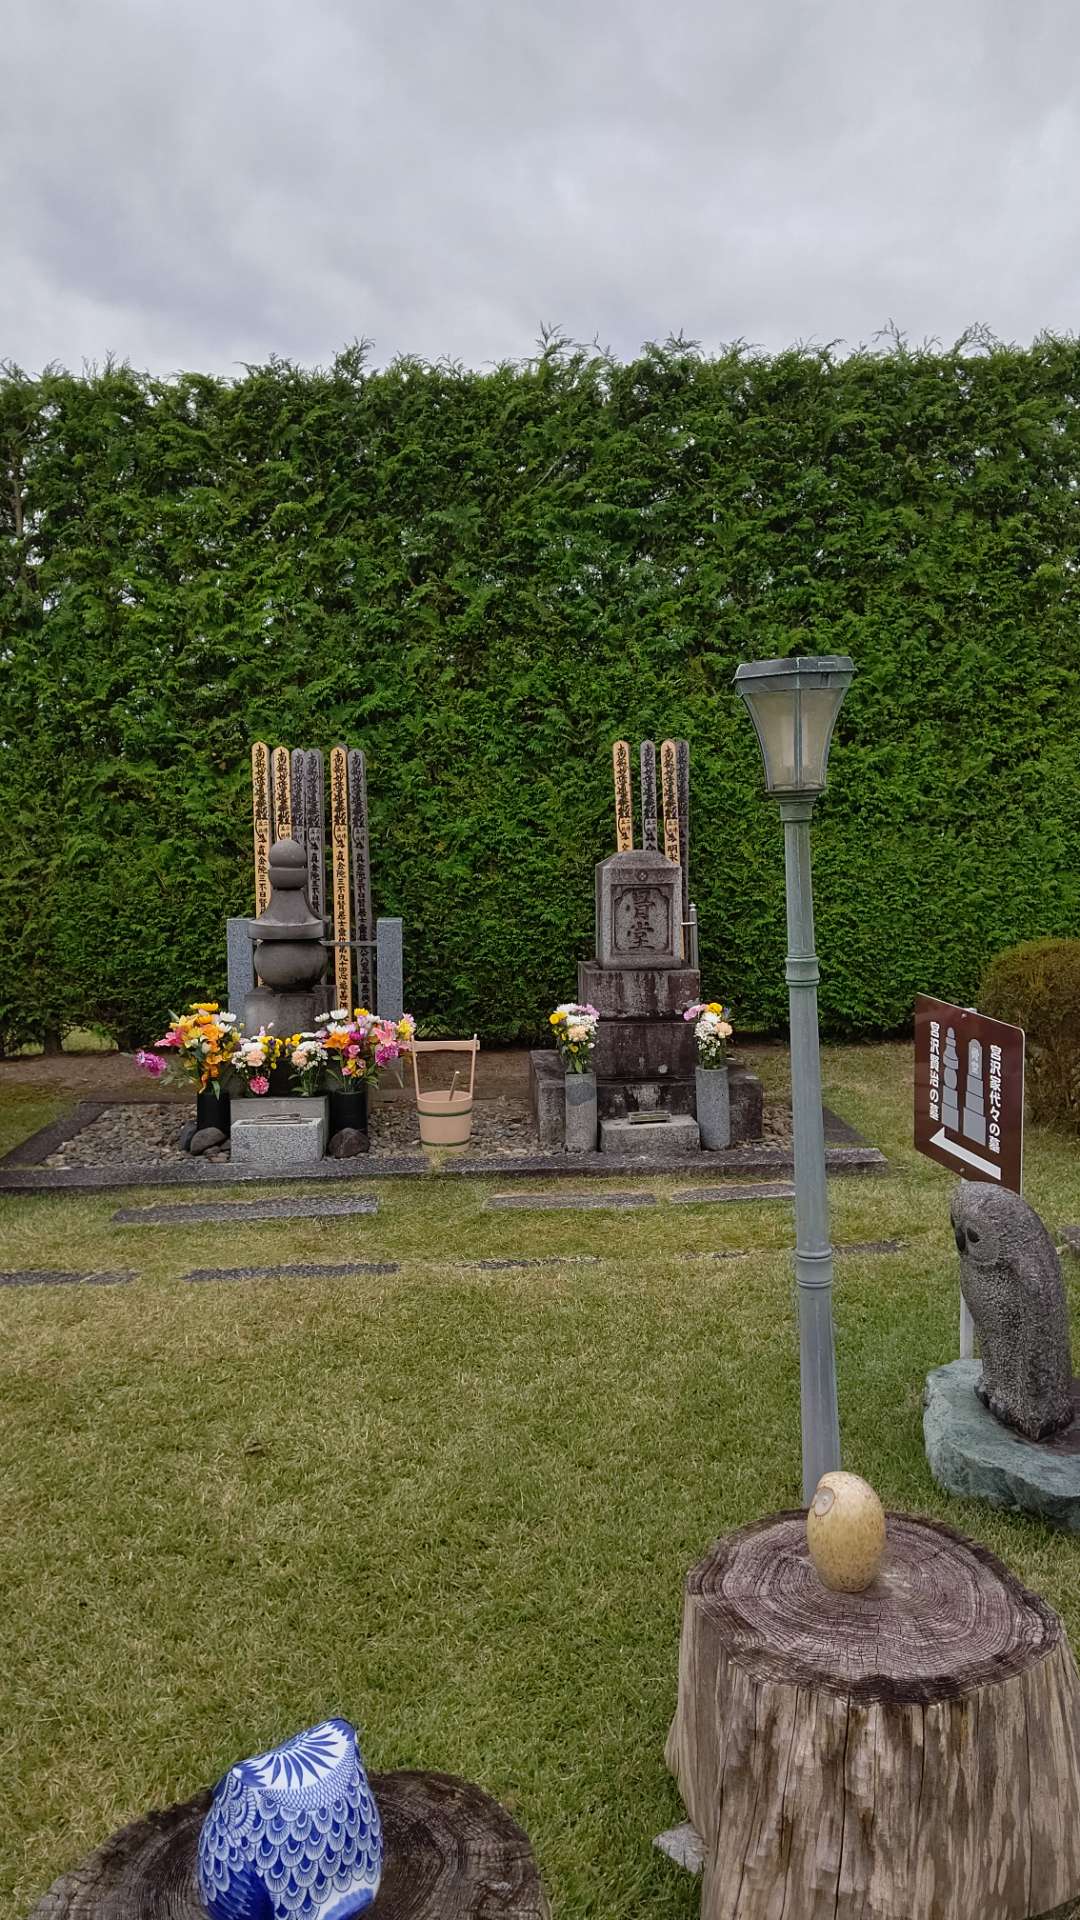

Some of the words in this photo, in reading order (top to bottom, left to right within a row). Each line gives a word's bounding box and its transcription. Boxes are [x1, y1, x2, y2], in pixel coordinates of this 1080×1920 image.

[930, 1022, 939, 1121] 宮沢賢治の墓
[989, 1045, 1002, 1153] 宮沢家代々の墓
